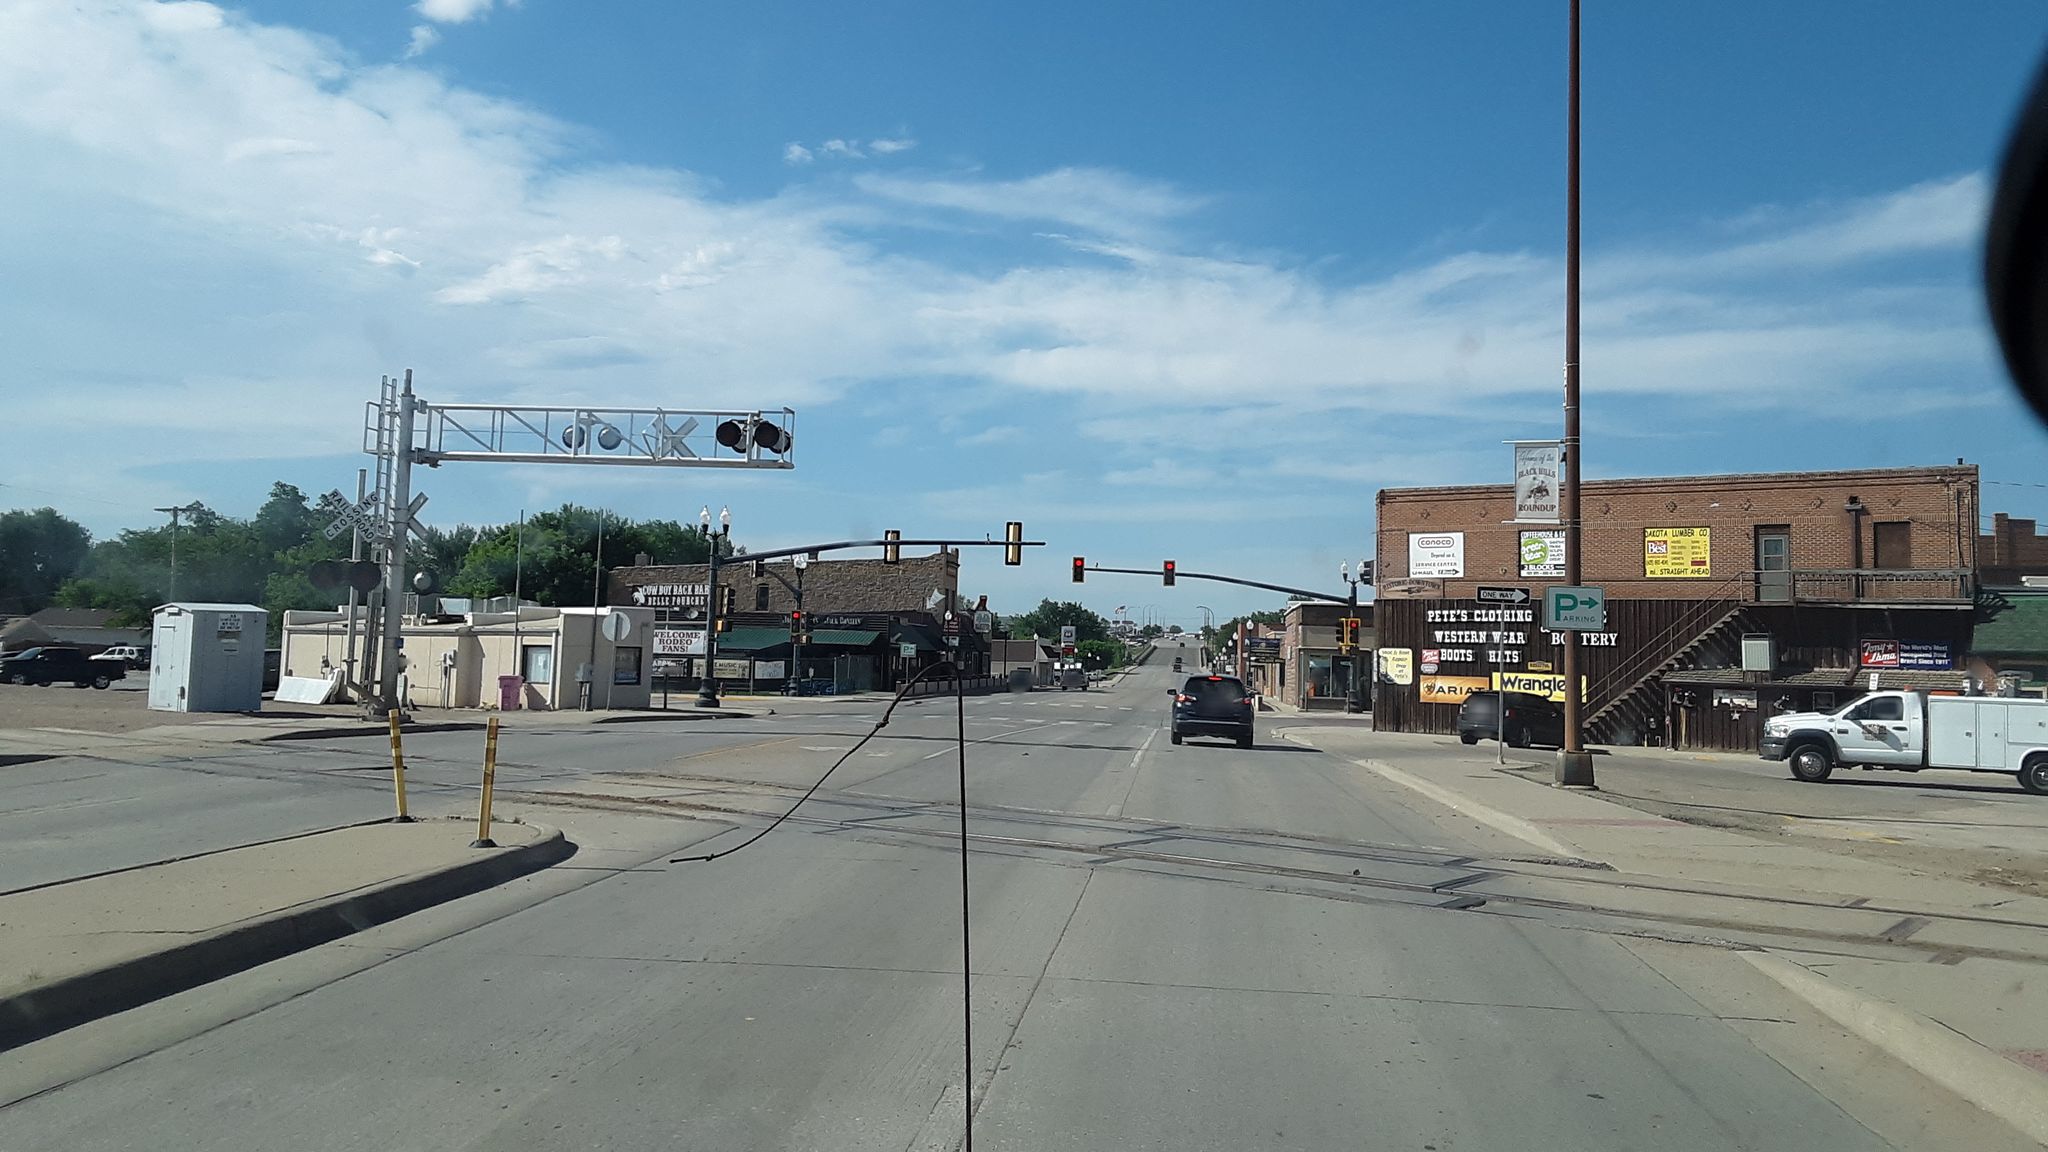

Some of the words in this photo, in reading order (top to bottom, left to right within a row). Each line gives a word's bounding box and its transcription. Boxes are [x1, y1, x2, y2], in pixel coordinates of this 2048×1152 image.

[1518, 468, 1537, 478] BLACK
[1538, 468, 1556, 478] HILLS
[1518, 503, 1556, 513] ROUNDUP
[1645, 529, 1668, 538] DAKOTA
[1672, 529, 1695, 538] LUMBER
[1648, 542, 1667, 554] Best
[1660, 568, 1689, 576] STRAIGHT
[1691, 567, 1710, 576] AHEAD
[673, 584, 693, 596] BACK
[1482, 591, 1497, 599] ONE
[647, 596, 670, 606] BELLE
[672, 596, 705, 606] FOURCHE
[1427, 609, 1468, 623] PETE'S
[1473, 609, 1533, 622] CLOTHING
[653, 631, 701, 639] WELCOME
[1434, 630, 1487, 643] WESTERN
[1491, 631, 1526, 644] WEAR
[659, 638, 693, 646] RODEO
[662, 645, 689, 653] FANS!
[1863, 642, 1887, 657] Tony
[1439, 648, 1474, 662] BOOTS
[1868, 652, 1897, 663] Lama
[1502, 675, 1566, 698] Wrangle
